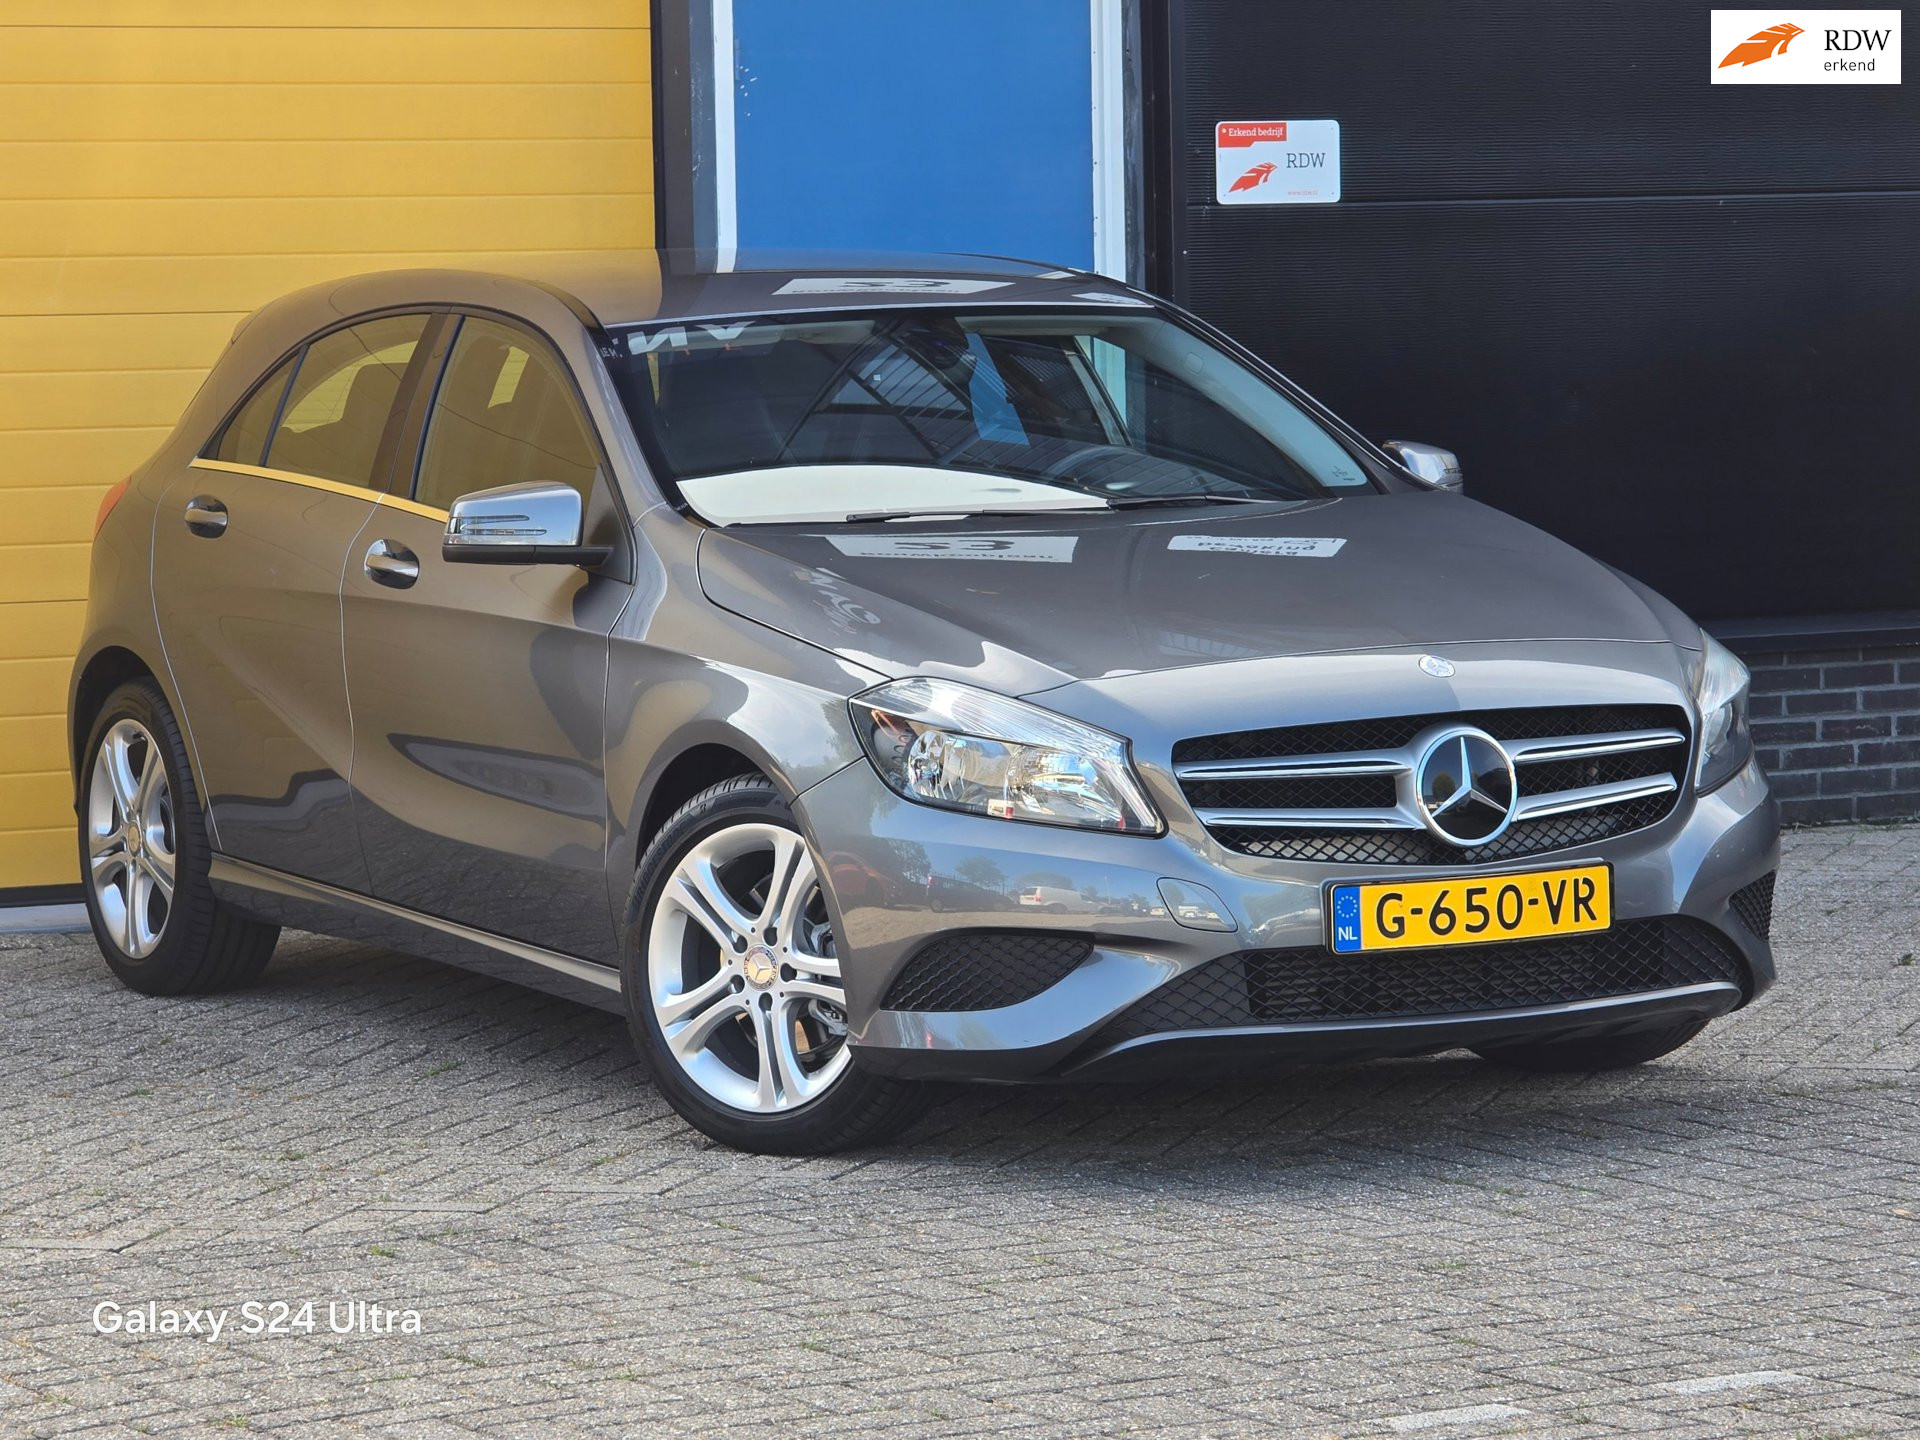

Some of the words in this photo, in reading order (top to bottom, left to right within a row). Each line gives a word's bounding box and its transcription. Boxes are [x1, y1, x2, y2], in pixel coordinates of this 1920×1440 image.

[1228, 127, 1256, 137] Erkend
[1257, 126, 1283, 139] bedrijf
[1286, 152, 1326, 169] RDW
[1375, 876, 1598, 939] G-650-VR
[1337, 925, 1358, 941] NL
